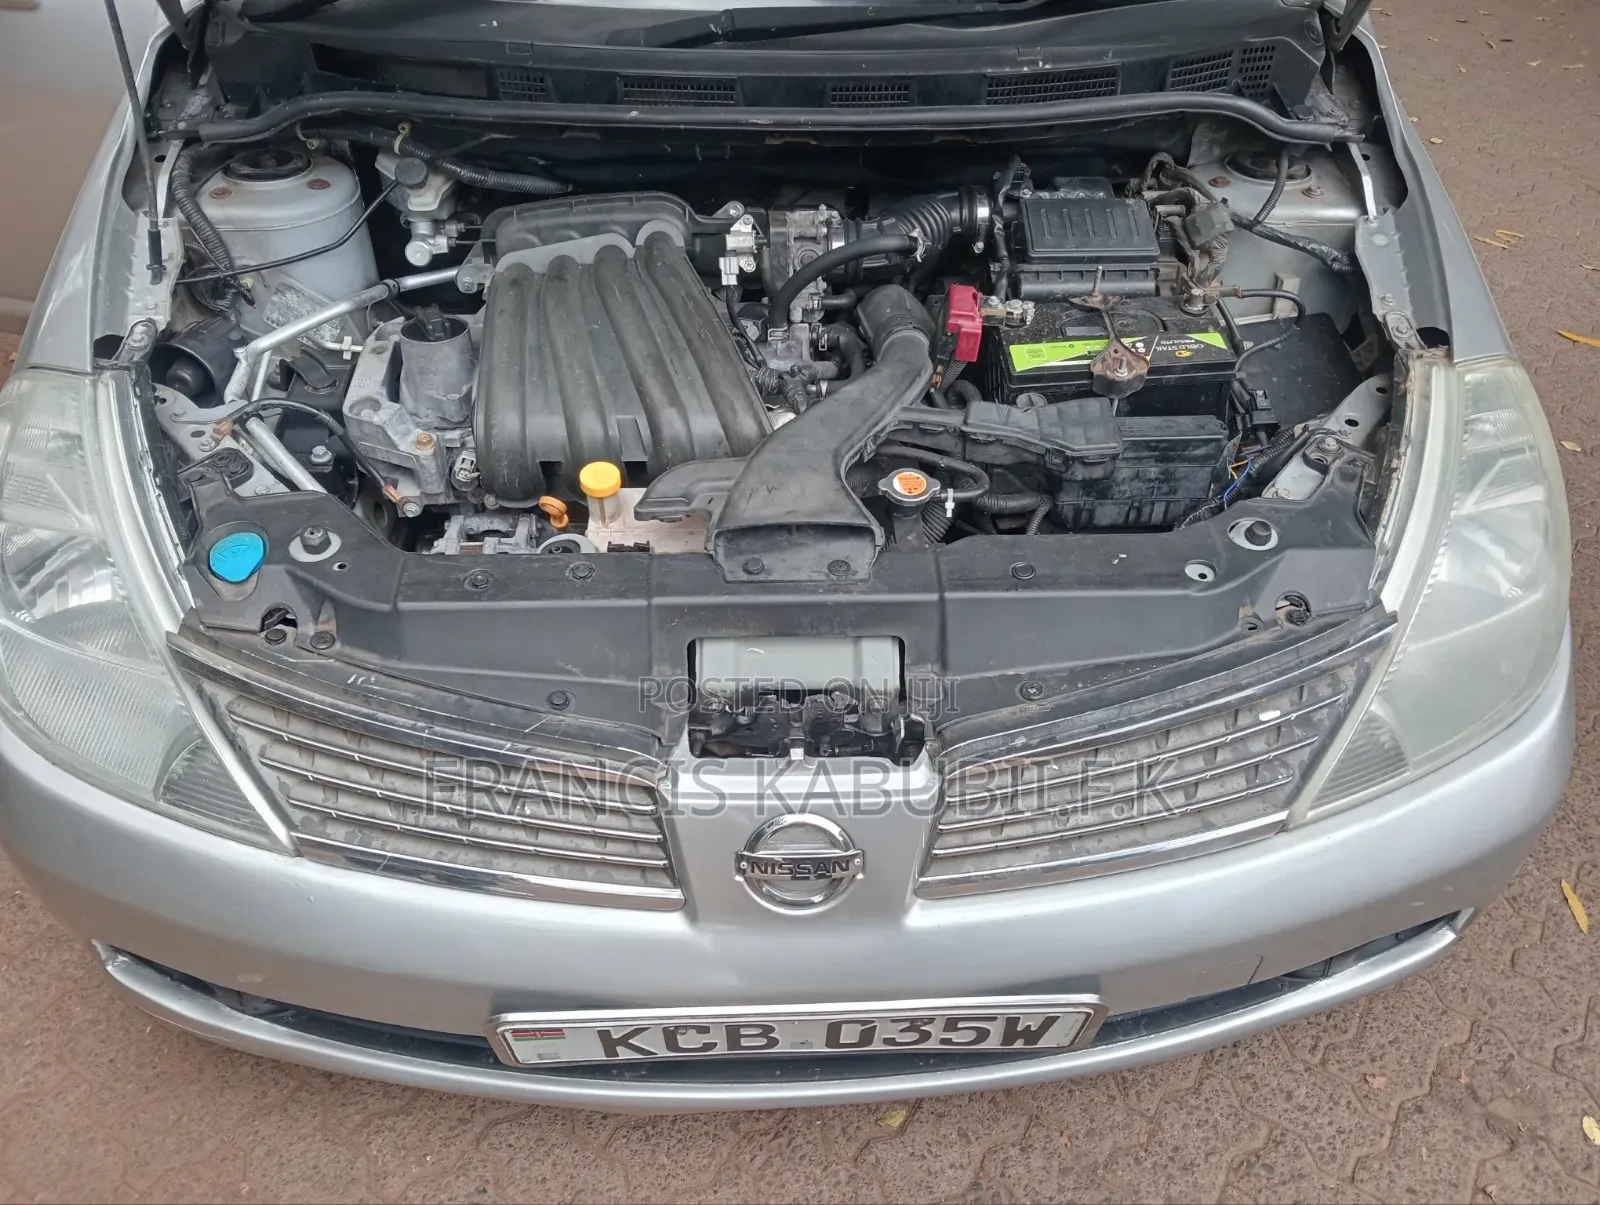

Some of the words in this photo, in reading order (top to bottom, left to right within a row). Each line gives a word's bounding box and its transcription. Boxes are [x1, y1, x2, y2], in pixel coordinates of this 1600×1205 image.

[750, 860, 850, 876] NISSAN
[597, 1023, 780, 1058] KCB
[825, 1015, 1062, 1050] 035W
